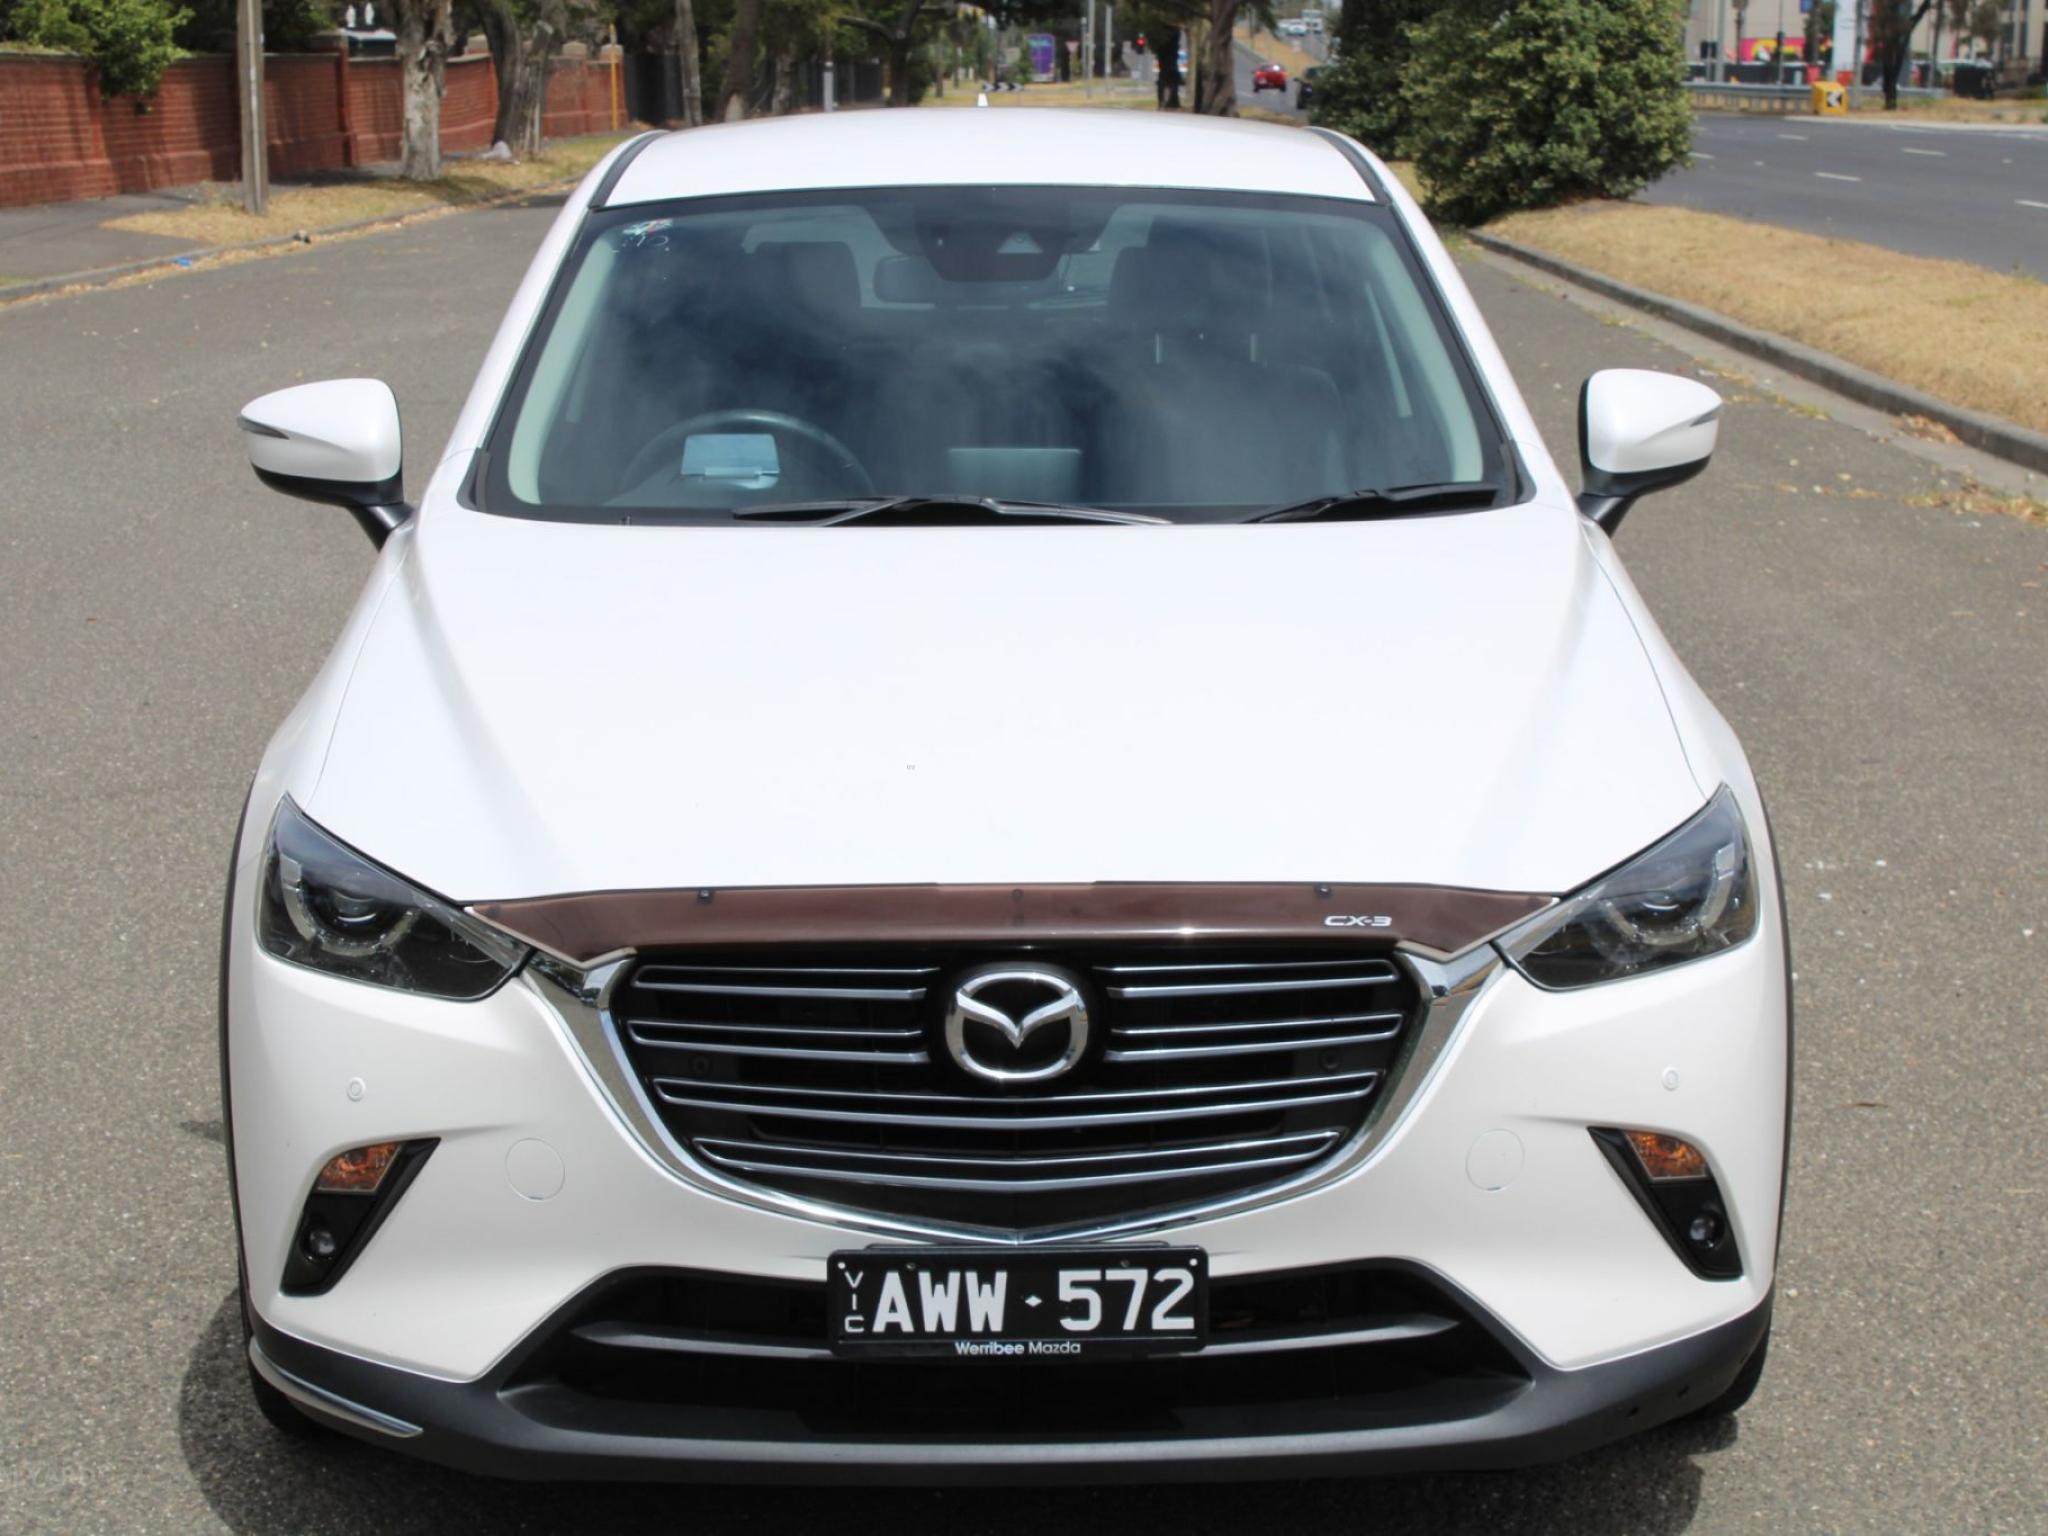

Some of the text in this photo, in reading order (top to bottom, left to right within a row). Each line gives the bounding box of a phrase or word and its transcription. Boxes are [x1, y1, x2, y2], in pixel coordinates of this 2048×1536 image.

[1324, 915, 1392, 927] CX-3
[844, 1271, 864, 1333] VIC
[872, 1268, 1195, 1333] AWW 572
[954, 1341, 1081, 1355] Werribee Mazda
